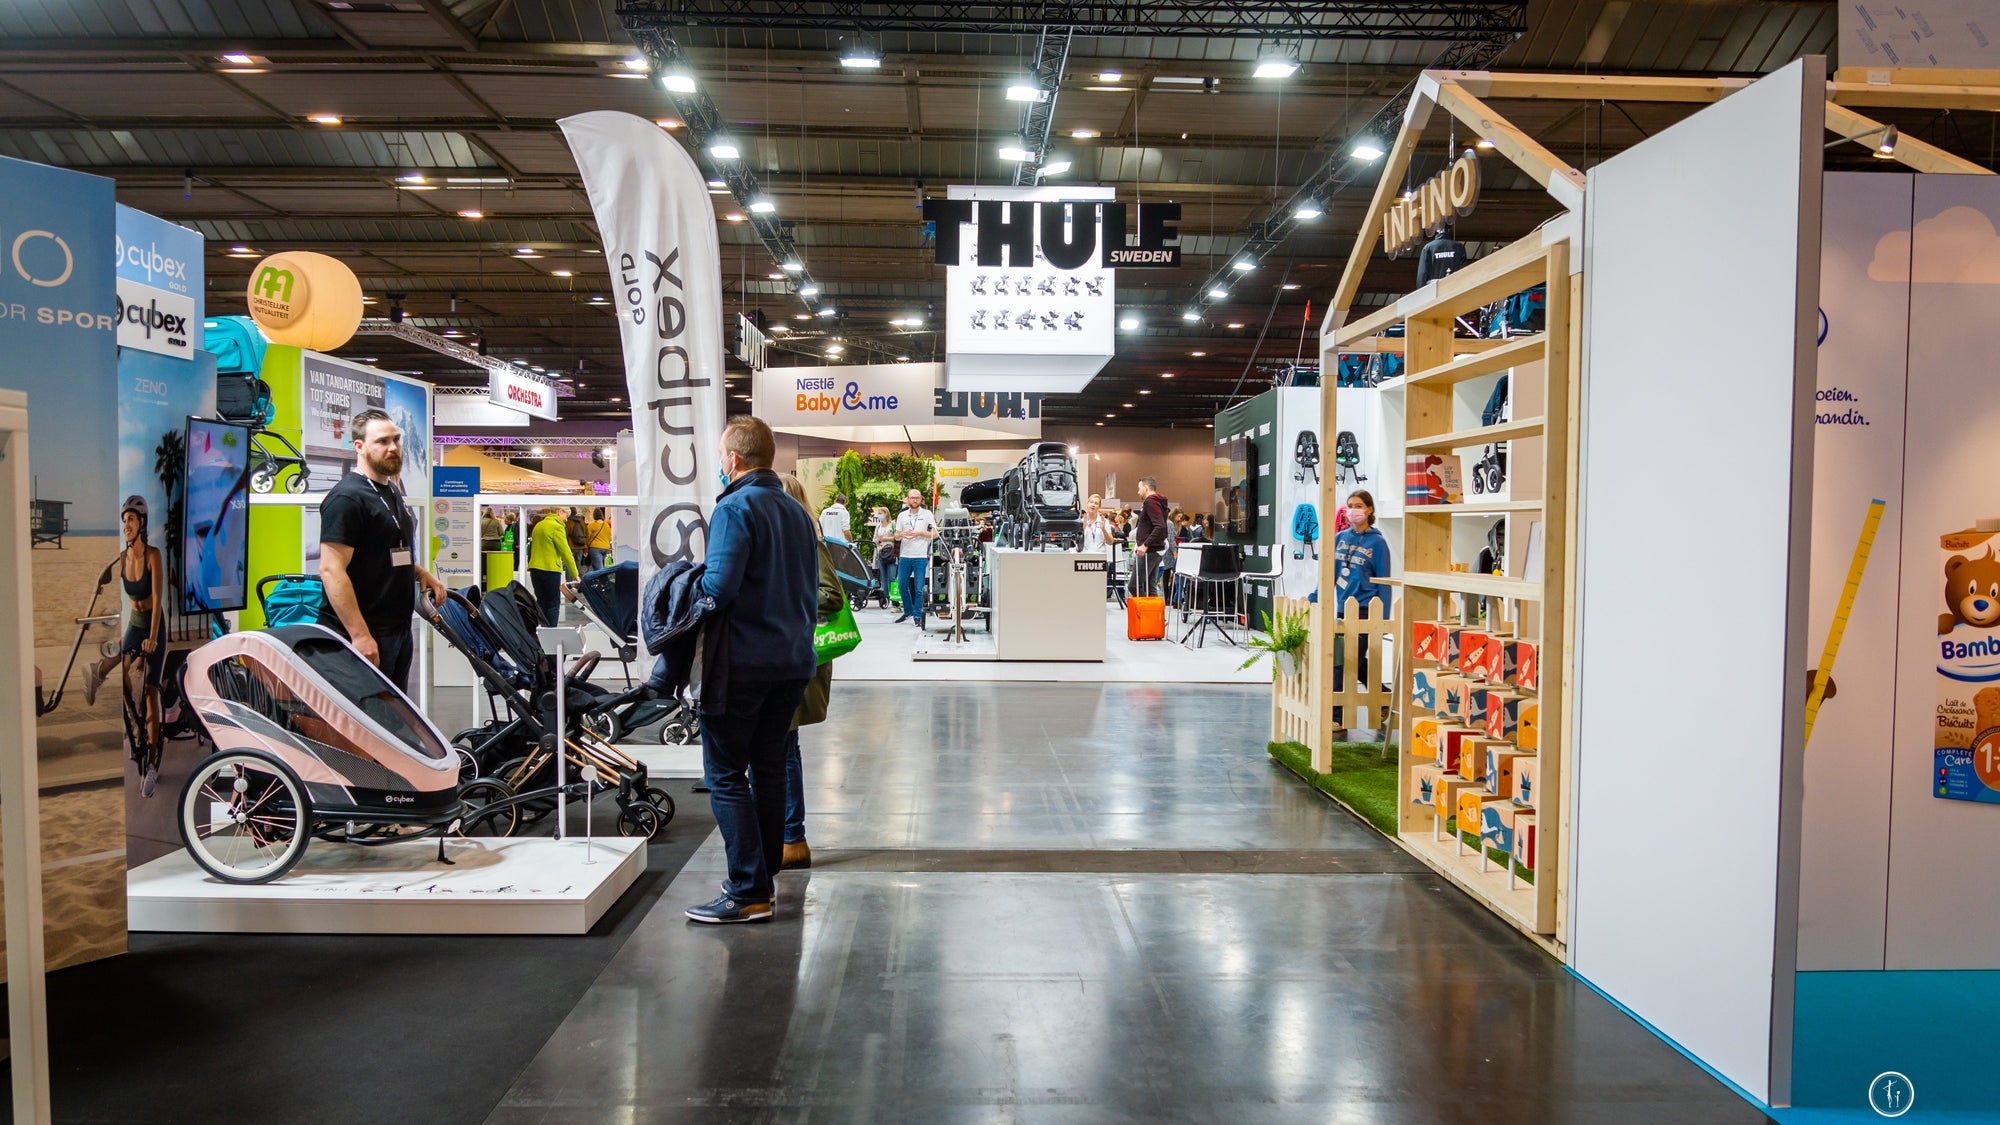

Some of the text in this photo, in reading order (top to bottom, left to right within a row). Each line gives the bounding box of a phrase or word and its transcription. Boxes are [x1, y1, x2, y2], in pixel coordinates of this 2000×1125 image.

[1384, 158, 1477, 254] INFINO
[922, 200, 1181, 270] THULE
[127, 242, 187, 282] cybex
[1110, 250, 1173, 263] SWEDEN
[168, 281, 188, 293] GOLD
[37, 307, 117, 331] SPOR
[126, 299, 187, 339] cybex
[254, 306, 289, 319] MUTUALITEIT
[168, 337, 187, 347] GOLD
[135, 378, 167, 397] ZENO
[310, 370, 382, 399] VAN TANDARTSBEZOEK
[310, 388, 350, 408] TOT SKIREIS
[507, 384, 542, 409] ORCHESTRA
[1816, 387, 1858, 401] oeien.
[796, 392, 841, 415] Baby
[868, 394, 898, 410] me
[1076, 562, 1104, 571] THULE
[1945, 698, 1959, 707] Lait
[1937, 705, 1975, 715] Croissance
[1937, 715, 1975, 729] Biscuits
[1936, 749, 1973, 757] COMPLETE
[1945, 755, 1973, 767] Care
[393, 795, 415, 804] cybex
